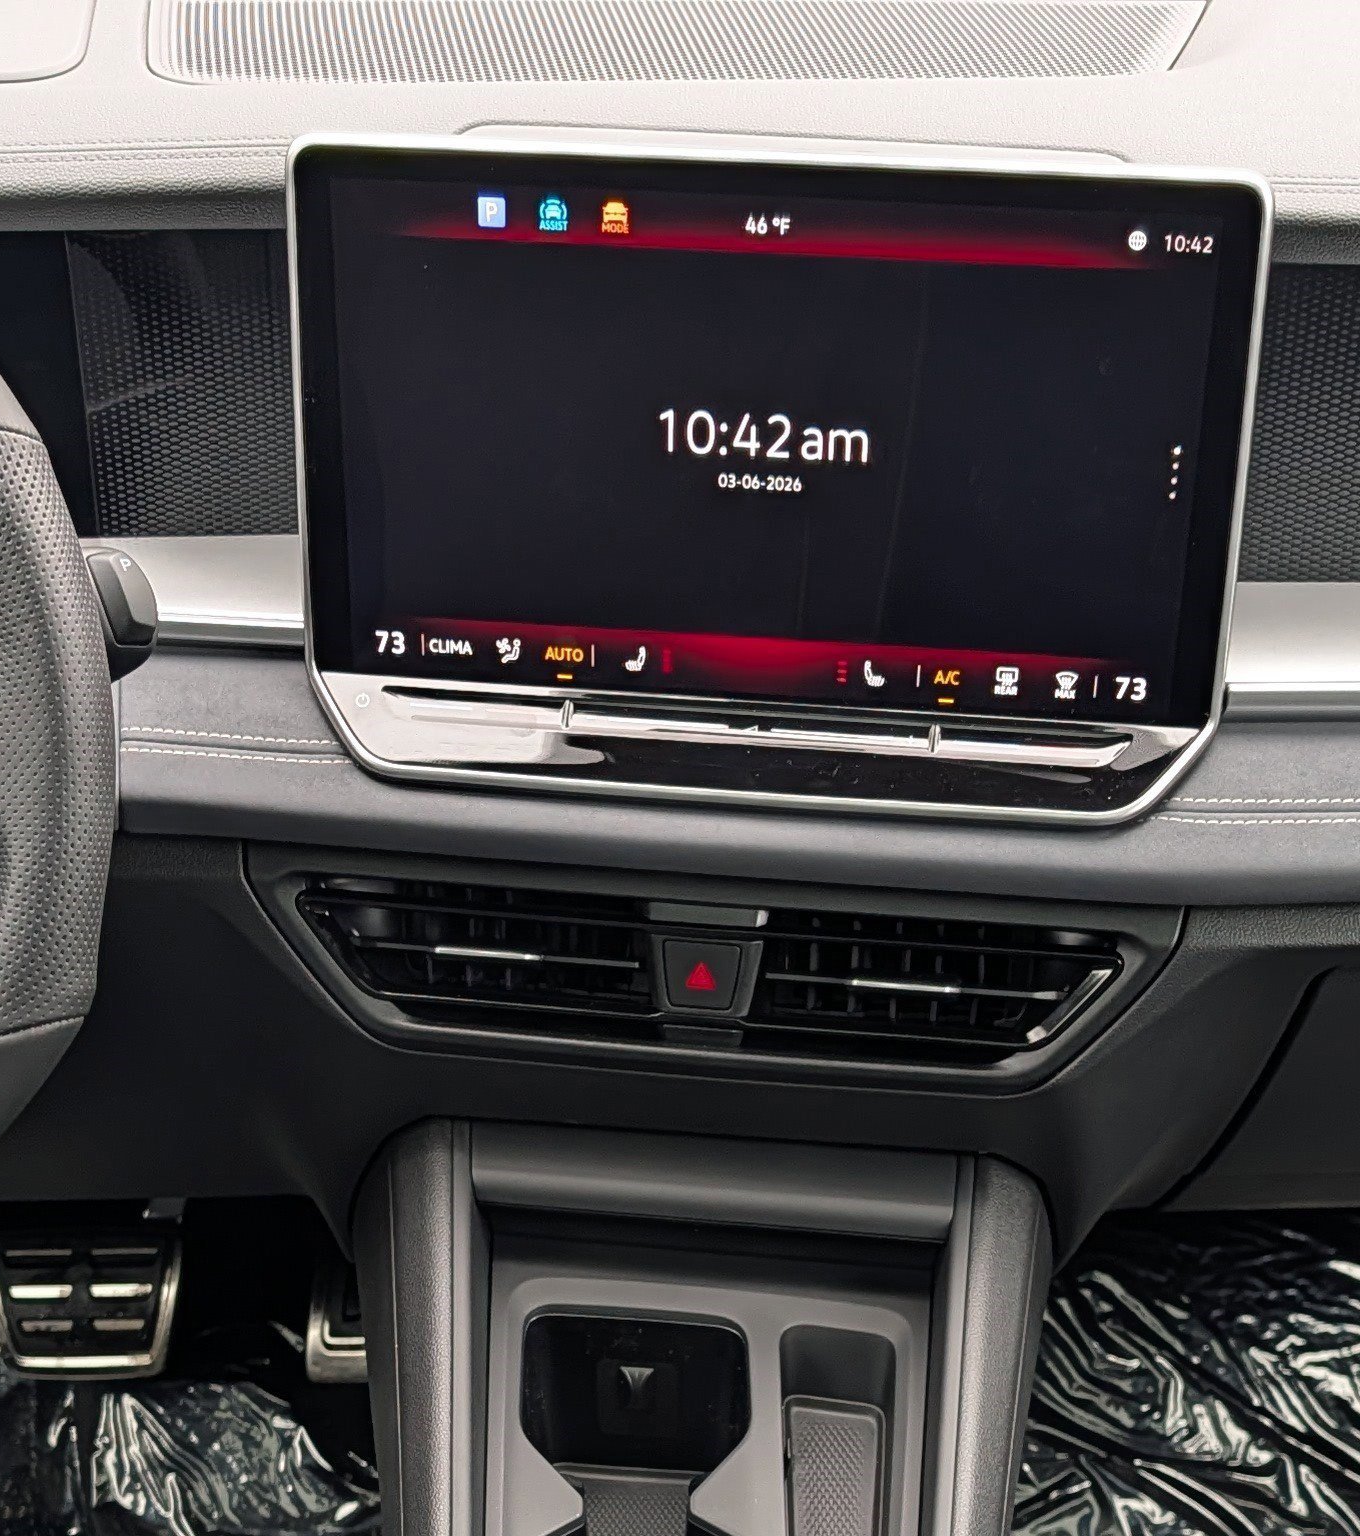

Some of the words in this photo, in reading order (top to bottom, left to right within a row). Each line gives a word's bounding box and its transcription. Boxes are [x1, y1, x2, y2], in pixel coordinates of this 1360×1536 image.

[539, 219, 568, 232] ASSIST
[601, 222, 629, 234] MODE
[745, 214, 768, 235] 46
[772, 217, 791, 235] °F
[1164, 233, 1214, 255] 10:42
[717, 473, 802, 492] 03-06-2026
[374, 630, 406, 655] 73
[428, 638, 473, 656] CLIMA
[545, 646, 584, 663] AUTO
[934, 669, 961, 686] A/C
[994, 684, 1018, 696] REAR
[1054, 689, 1076, 700] MAX
[1114, 676, 1147, 701] 73
